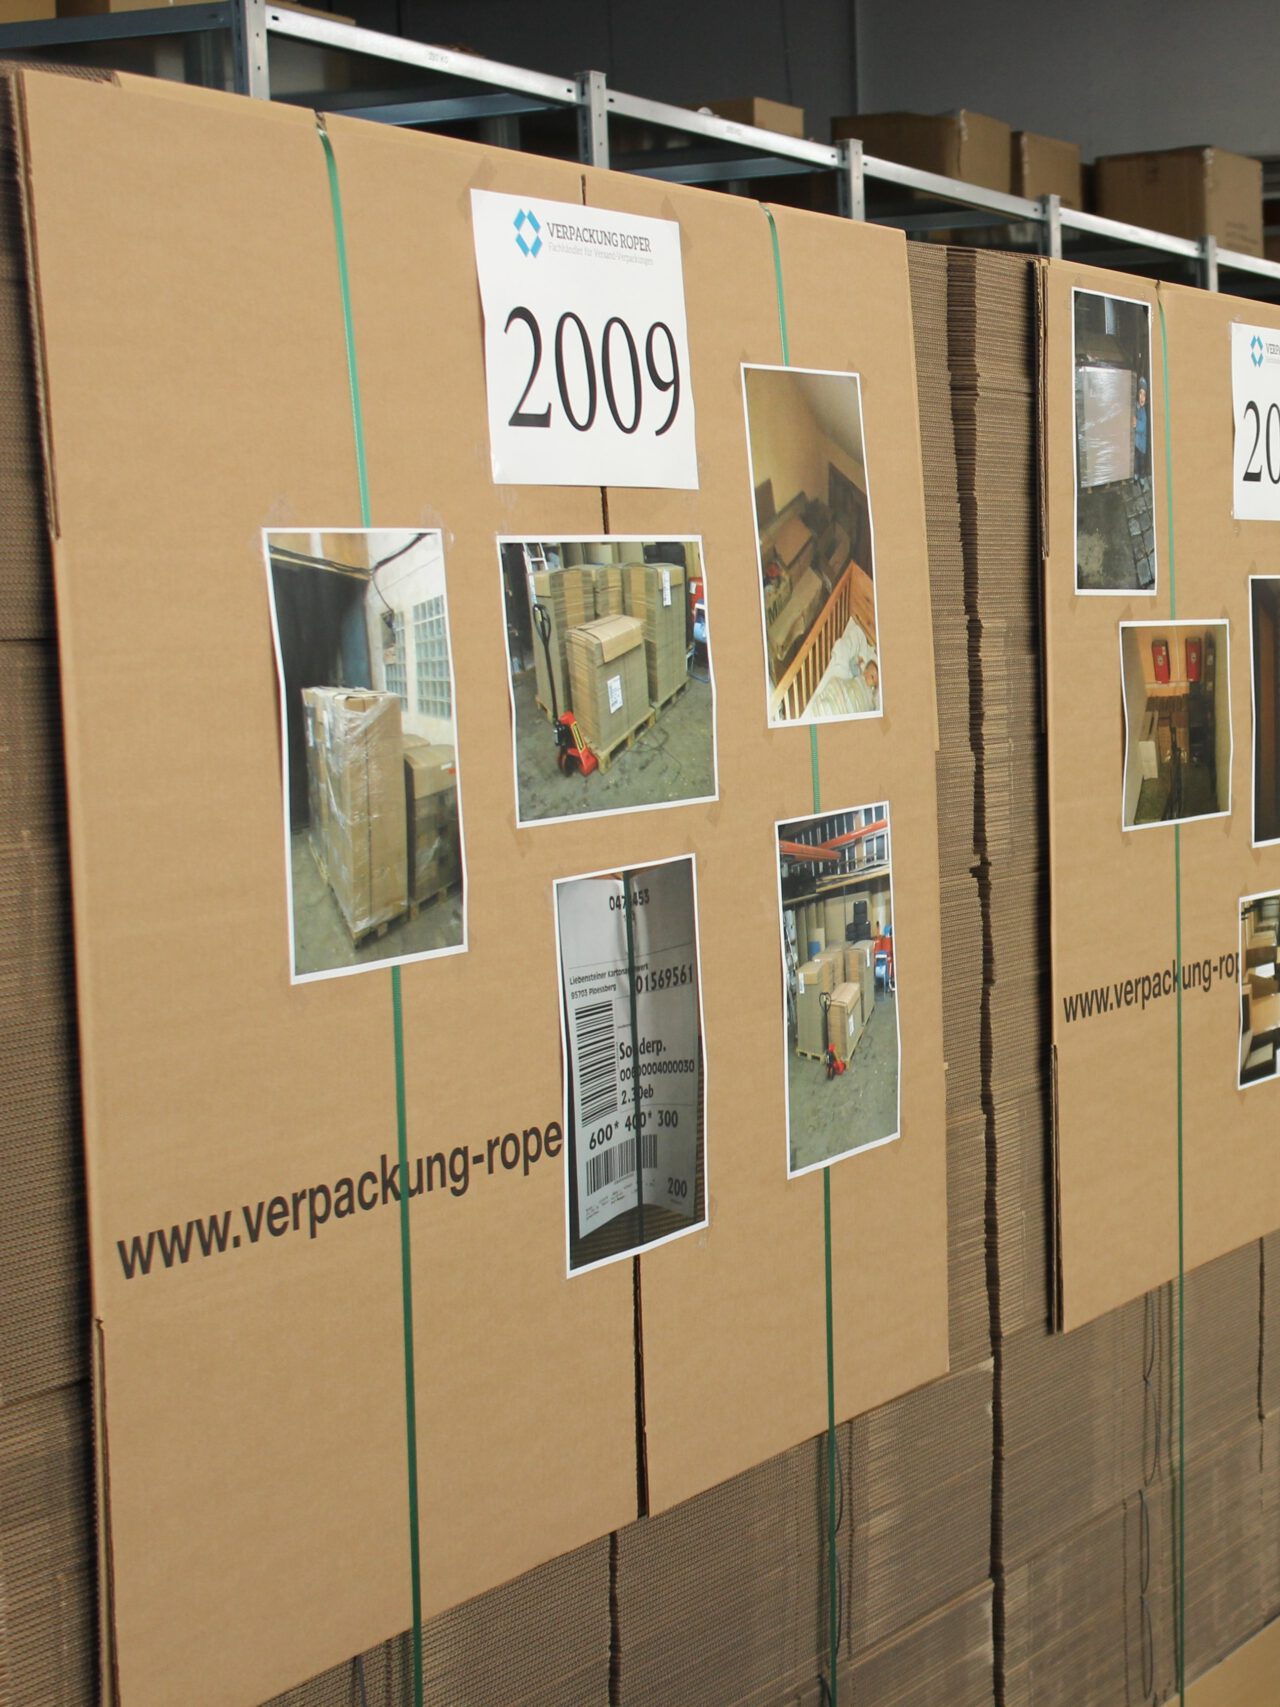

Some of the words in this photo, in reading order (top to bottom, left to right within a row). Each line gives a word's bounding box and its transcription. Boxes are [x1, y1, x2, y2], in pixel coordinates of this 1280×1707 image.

[546, 222, 619, 247] VERPACKUNG
[619, 233, 652, 253] ROPER
[503, 306, 681, 437] 2009
[635, 963, 693, 993] 01569561
[619, 1037, 666, 1060] Soderp.
[657, 1110, 679, 1128] 300
[116, 1120, 564, 1280] www.verpackung-rope
[667, 1177, 688, 1198] 200
